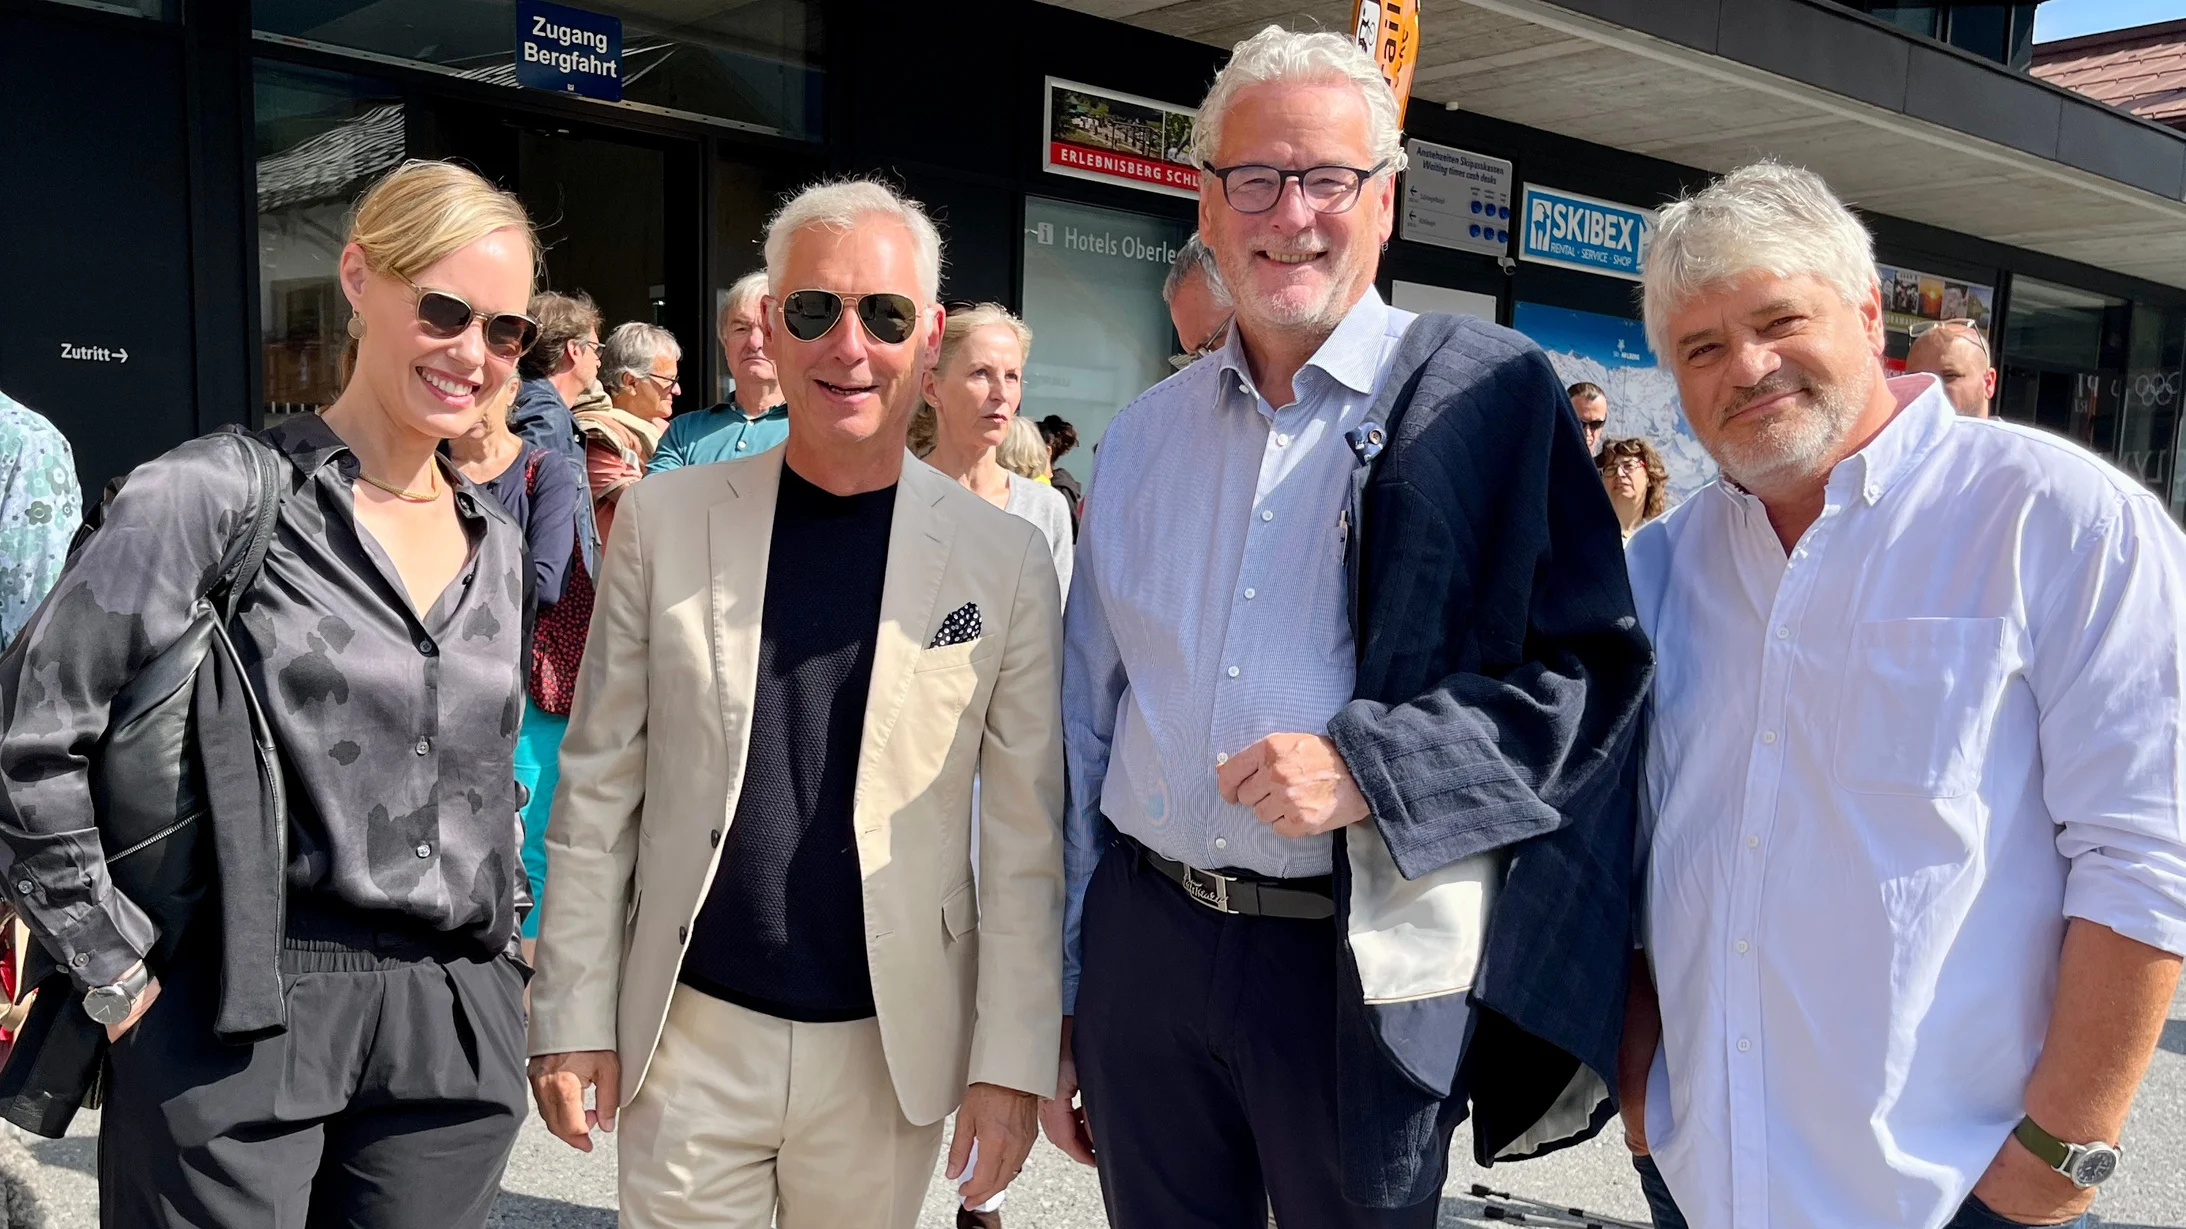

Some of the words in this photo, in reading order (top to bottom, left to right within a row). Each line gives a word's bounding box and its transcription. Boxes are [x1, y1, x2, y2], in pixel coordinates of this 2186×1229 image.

[532, 15, 607, 54] Zugang
[523, 41, 617, 78] Bergfahrt
[1061, 148, 1162, 180] ERLEBNISBERG
[1422, 160, 1449, 176] Waiting
[1448, 166, 1466, 177] times
[1466, 172, 1480, 181] cash
[1065, 226, 1118, 256] Hotels
[1553, 203, 1634, 252] SKIBEX
[1550, 242, 1576, 257] RENTAL
[1581, 248, 1608, 263] SERVICE
[1612, 254, 1632, 266] SHOP
[61, 343, 110, 361] Zutritt
